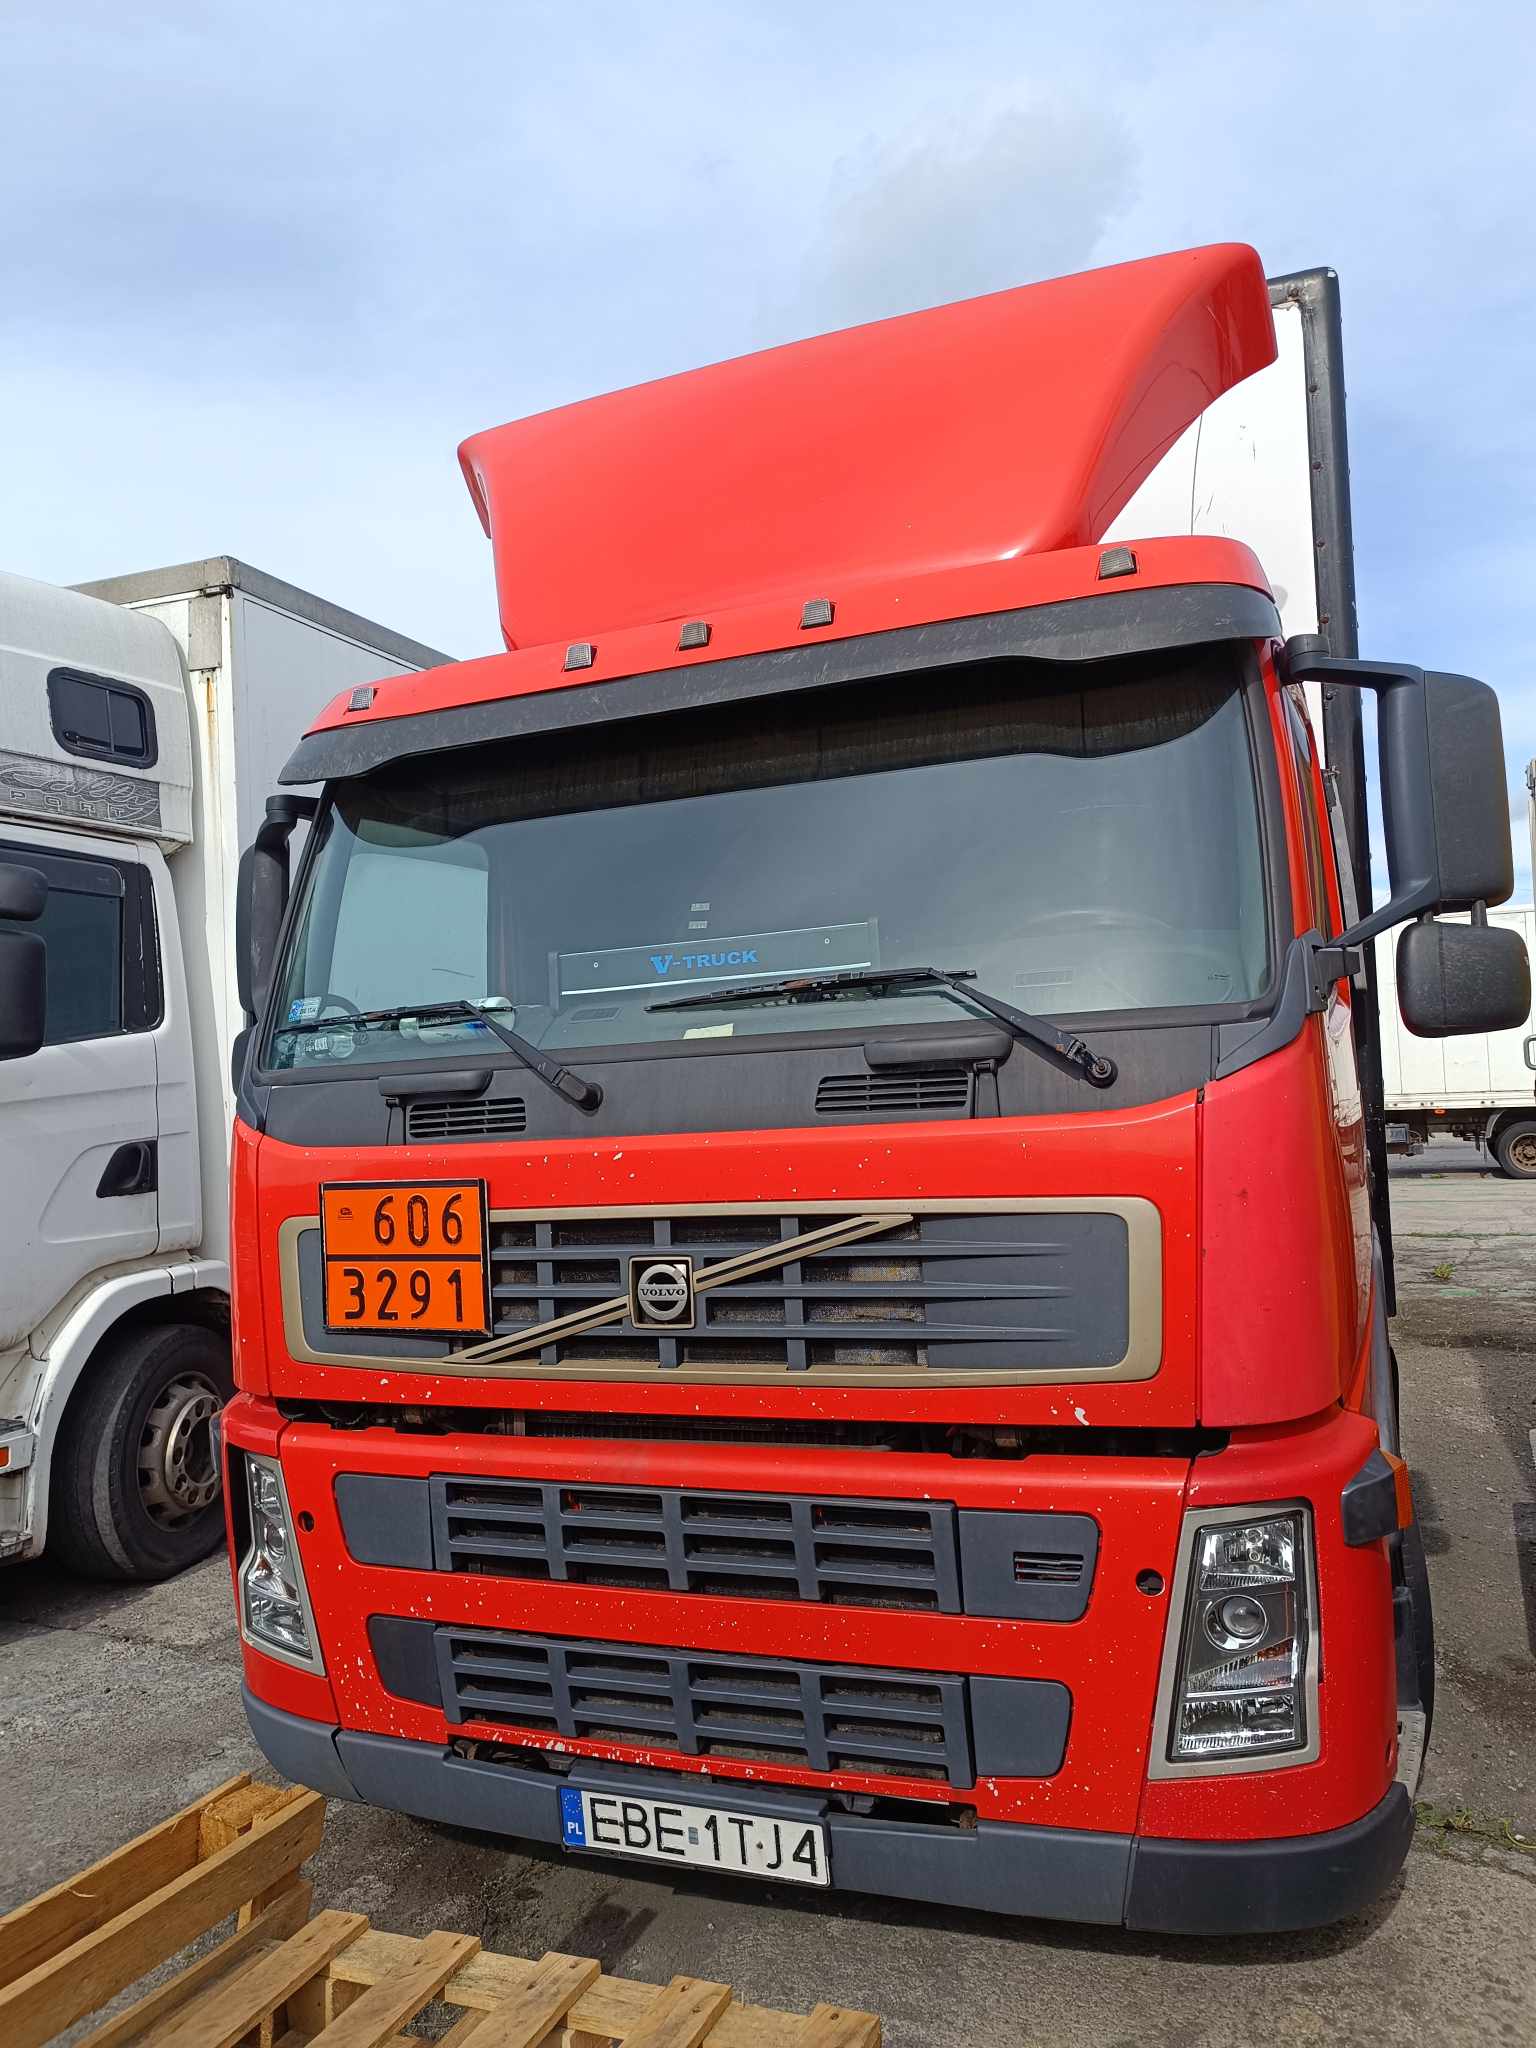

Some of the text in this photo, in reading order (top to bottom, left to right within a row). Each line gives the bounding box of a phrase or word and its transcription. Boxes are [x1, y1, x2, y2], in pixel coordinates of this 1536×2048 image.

[650, 950, 759, 975] V-TRUCK
[374, 1193, 463, 1246] 606
[343, 1267, 463, 1323] 3291
[640, 1288, 686, 1297] VOLVO
[567, 1821, 583, 1836] PL
[589, 1796, 818, 1878] EBE 1TJ4
